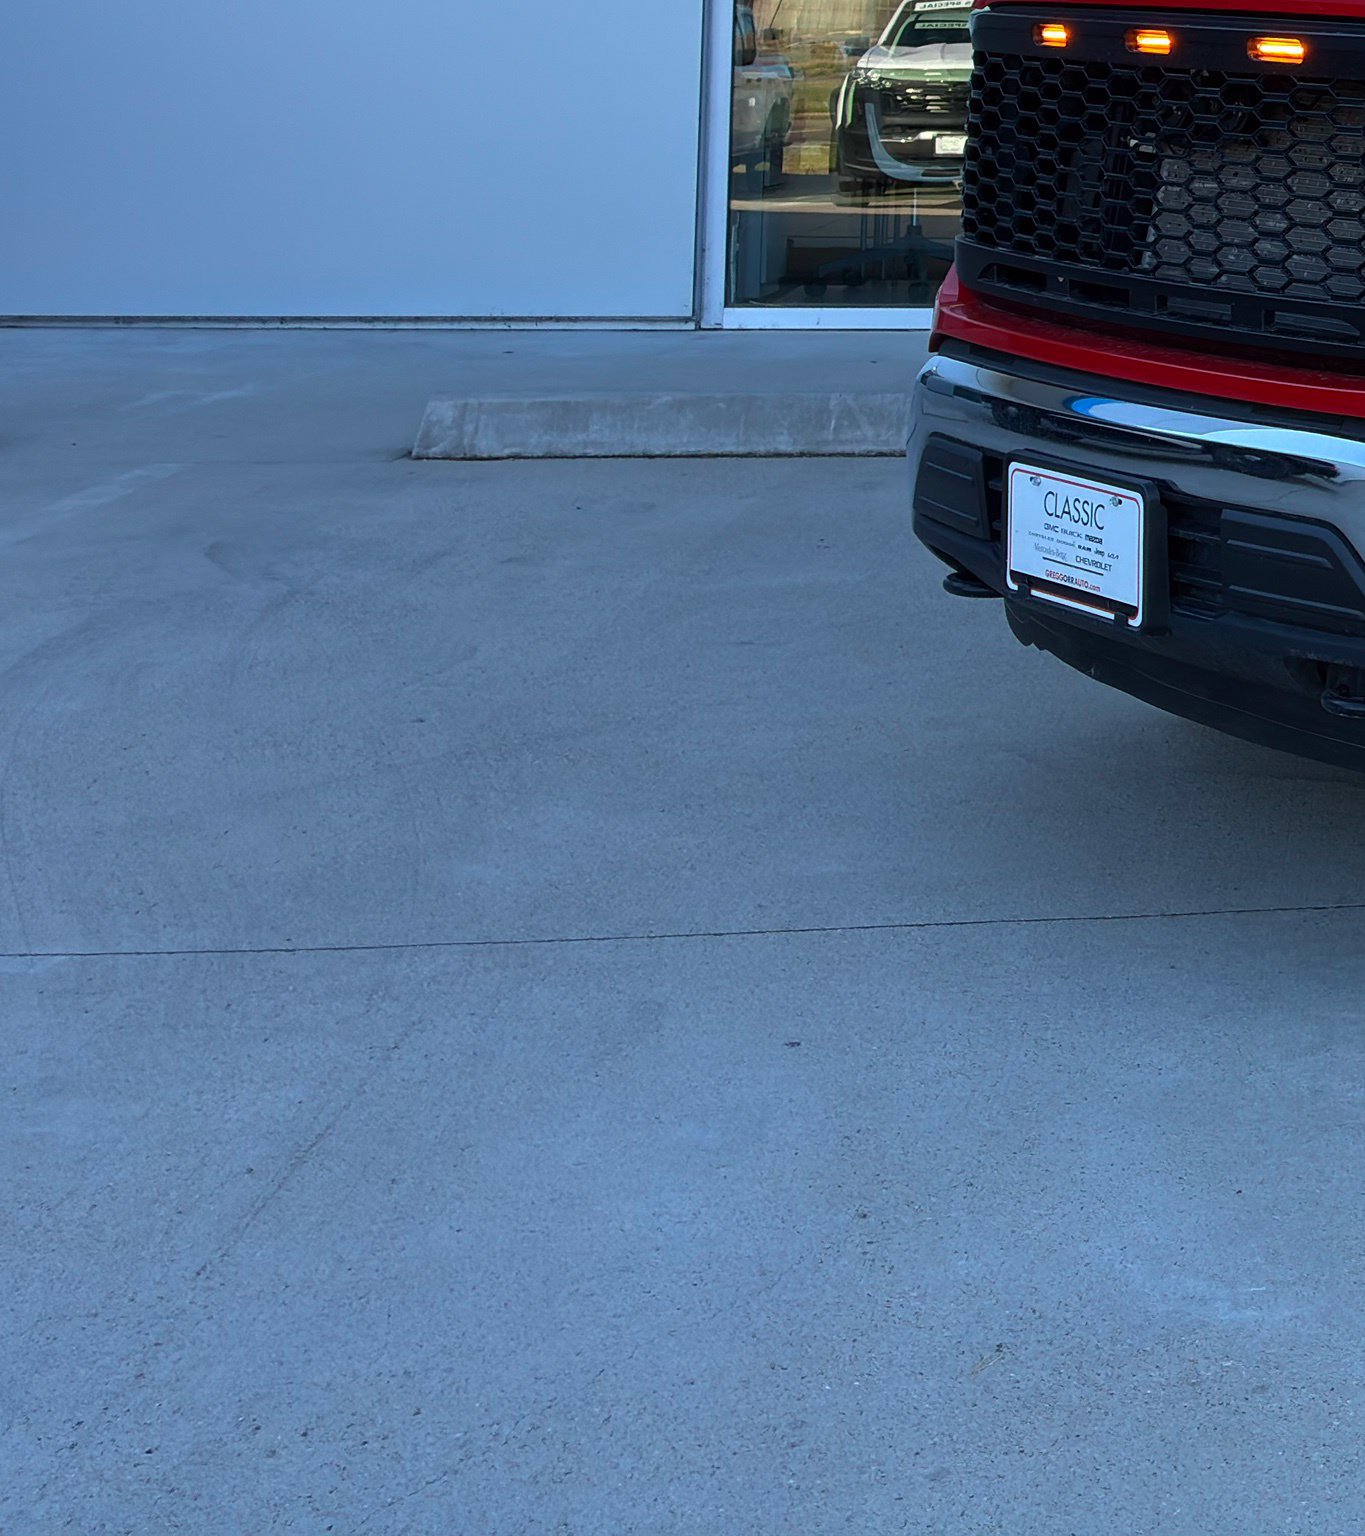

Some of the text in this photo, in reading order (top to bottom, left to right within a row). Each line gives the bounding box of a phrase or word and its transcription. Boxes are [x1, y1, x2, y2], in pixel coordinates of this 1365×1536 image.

[1044, 491, 1105, 530] CLASSIC
[1044, 522, 1059, 535] GMC
[1060, 527, 1083, 540] BUICK
[1078, 545, 1092, 553] RAM
[1076, 555, 1112, 571] CHEVROLET
[1045, 569, 1101, 592] GREGGORRAUTO.com
